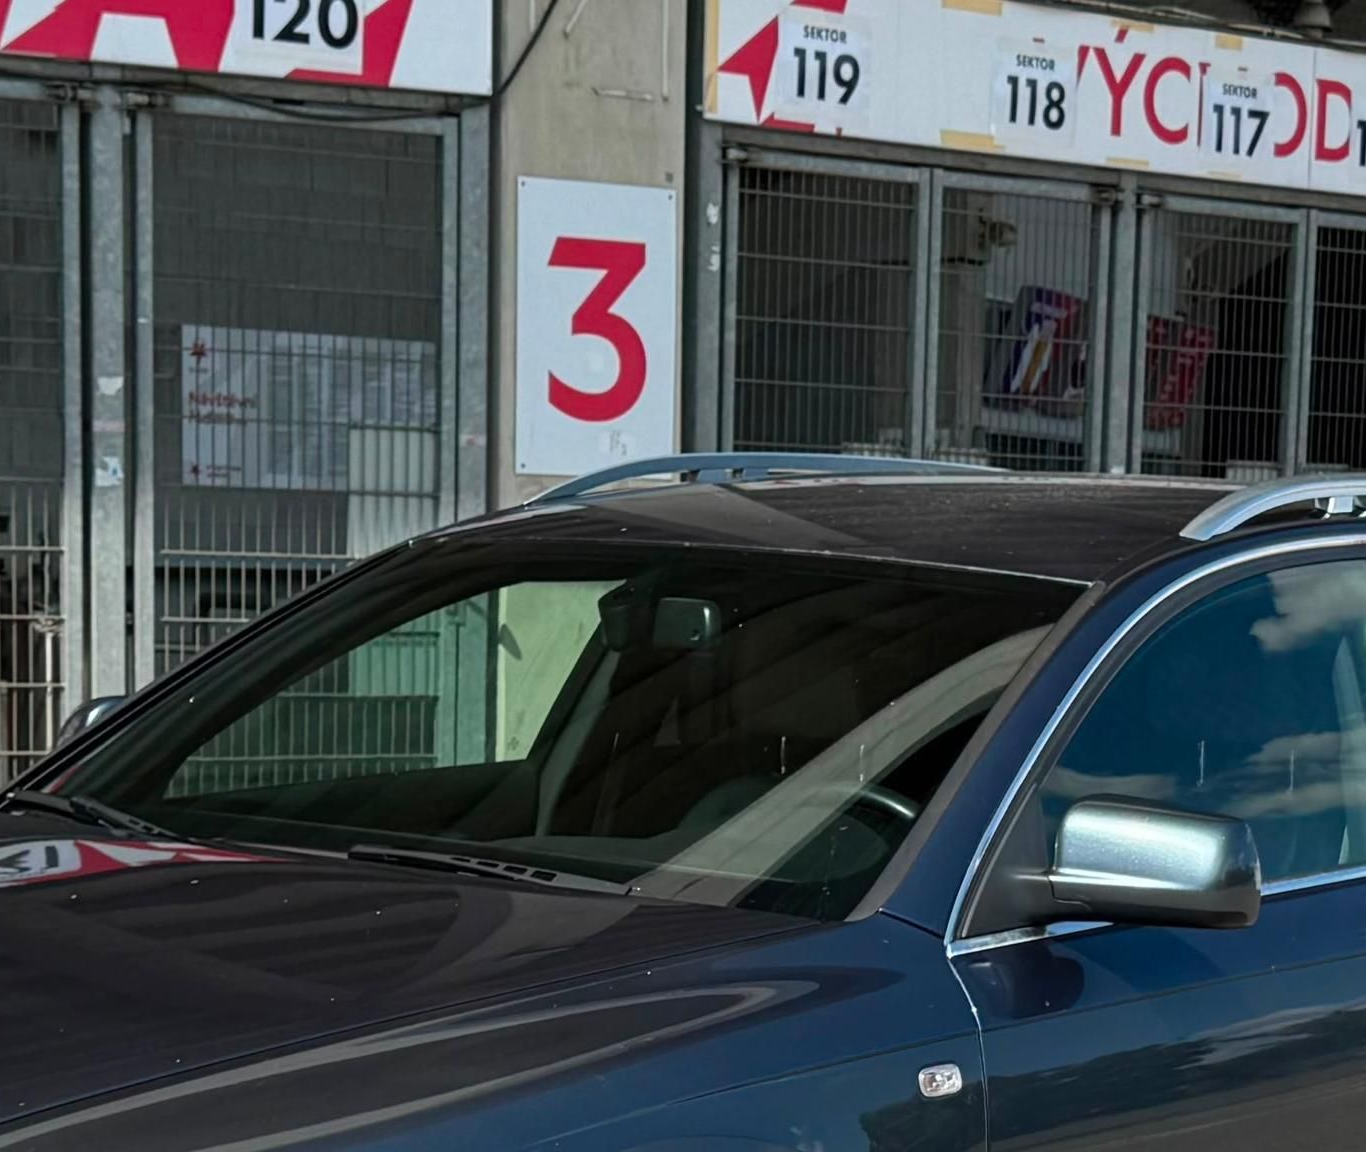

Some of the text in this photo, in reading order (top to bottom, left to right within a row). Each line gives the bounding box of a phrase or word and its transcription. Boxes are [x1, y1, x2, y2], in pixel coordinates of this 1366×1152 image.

[802, 24, 848, 45] SEKTOR
[793, 47, 861, 105] 119
[1015, 54, 1056, 72] SEKTOR
[1007, 75, 1067, 130] 118
[1076, 28, 1353, 163] ÝCOD
[1222, 83, 1258, 99] SEKTOR
[1212, 103, 1271, 157] 117
[547, 235, 648, 423] 3
